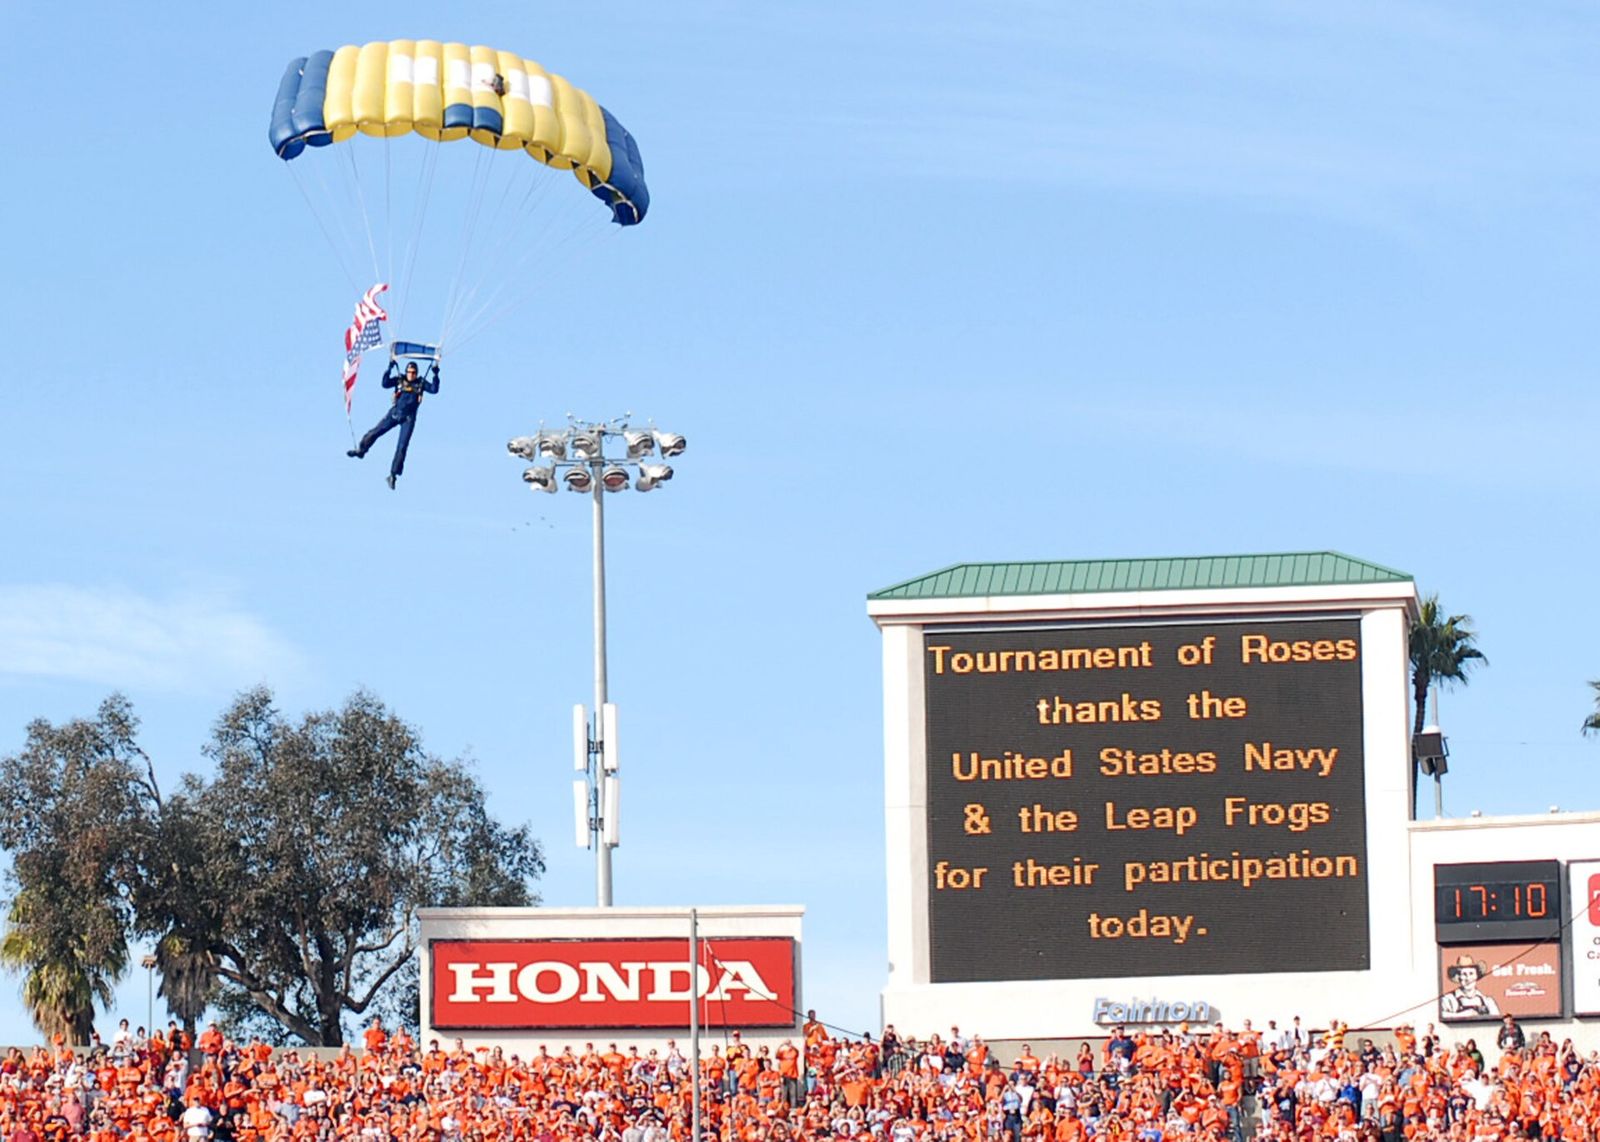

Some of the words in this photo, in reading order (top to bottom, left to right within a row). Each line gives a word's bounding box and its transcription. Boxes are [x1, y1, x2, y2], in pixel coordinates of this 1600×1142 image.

[928, 642, 1152, 674] Tournament
[1177, 637, 1216, 666] of
[1242, 634, 1357, 663] Roses
[1037, 693, 1161, 724] thanks
[1187, 690, 1247, 719] the
[952, 749, 1072, 780] United
[1099, 747, 1217, 776] States
[1244, 742, 1339, 777] Navy
[963, 803, 992, 835] &
[1018, 804, 1078, 833] the
[1105, 802, 1197, 835] Leap
[1225, 797, 1330, 832] Frogs
[934, 861, 988, 890] for
[1013, 857, 1099, 887] their
[1125, 849, 1358, 891] participation
[1455, 883, 1546, 918] 17:10
[1088, 908, 1207, 944] today.
[448, 961, 777, 1003] HONDA
[1092, 996, 1209, 1023] Fairtron
